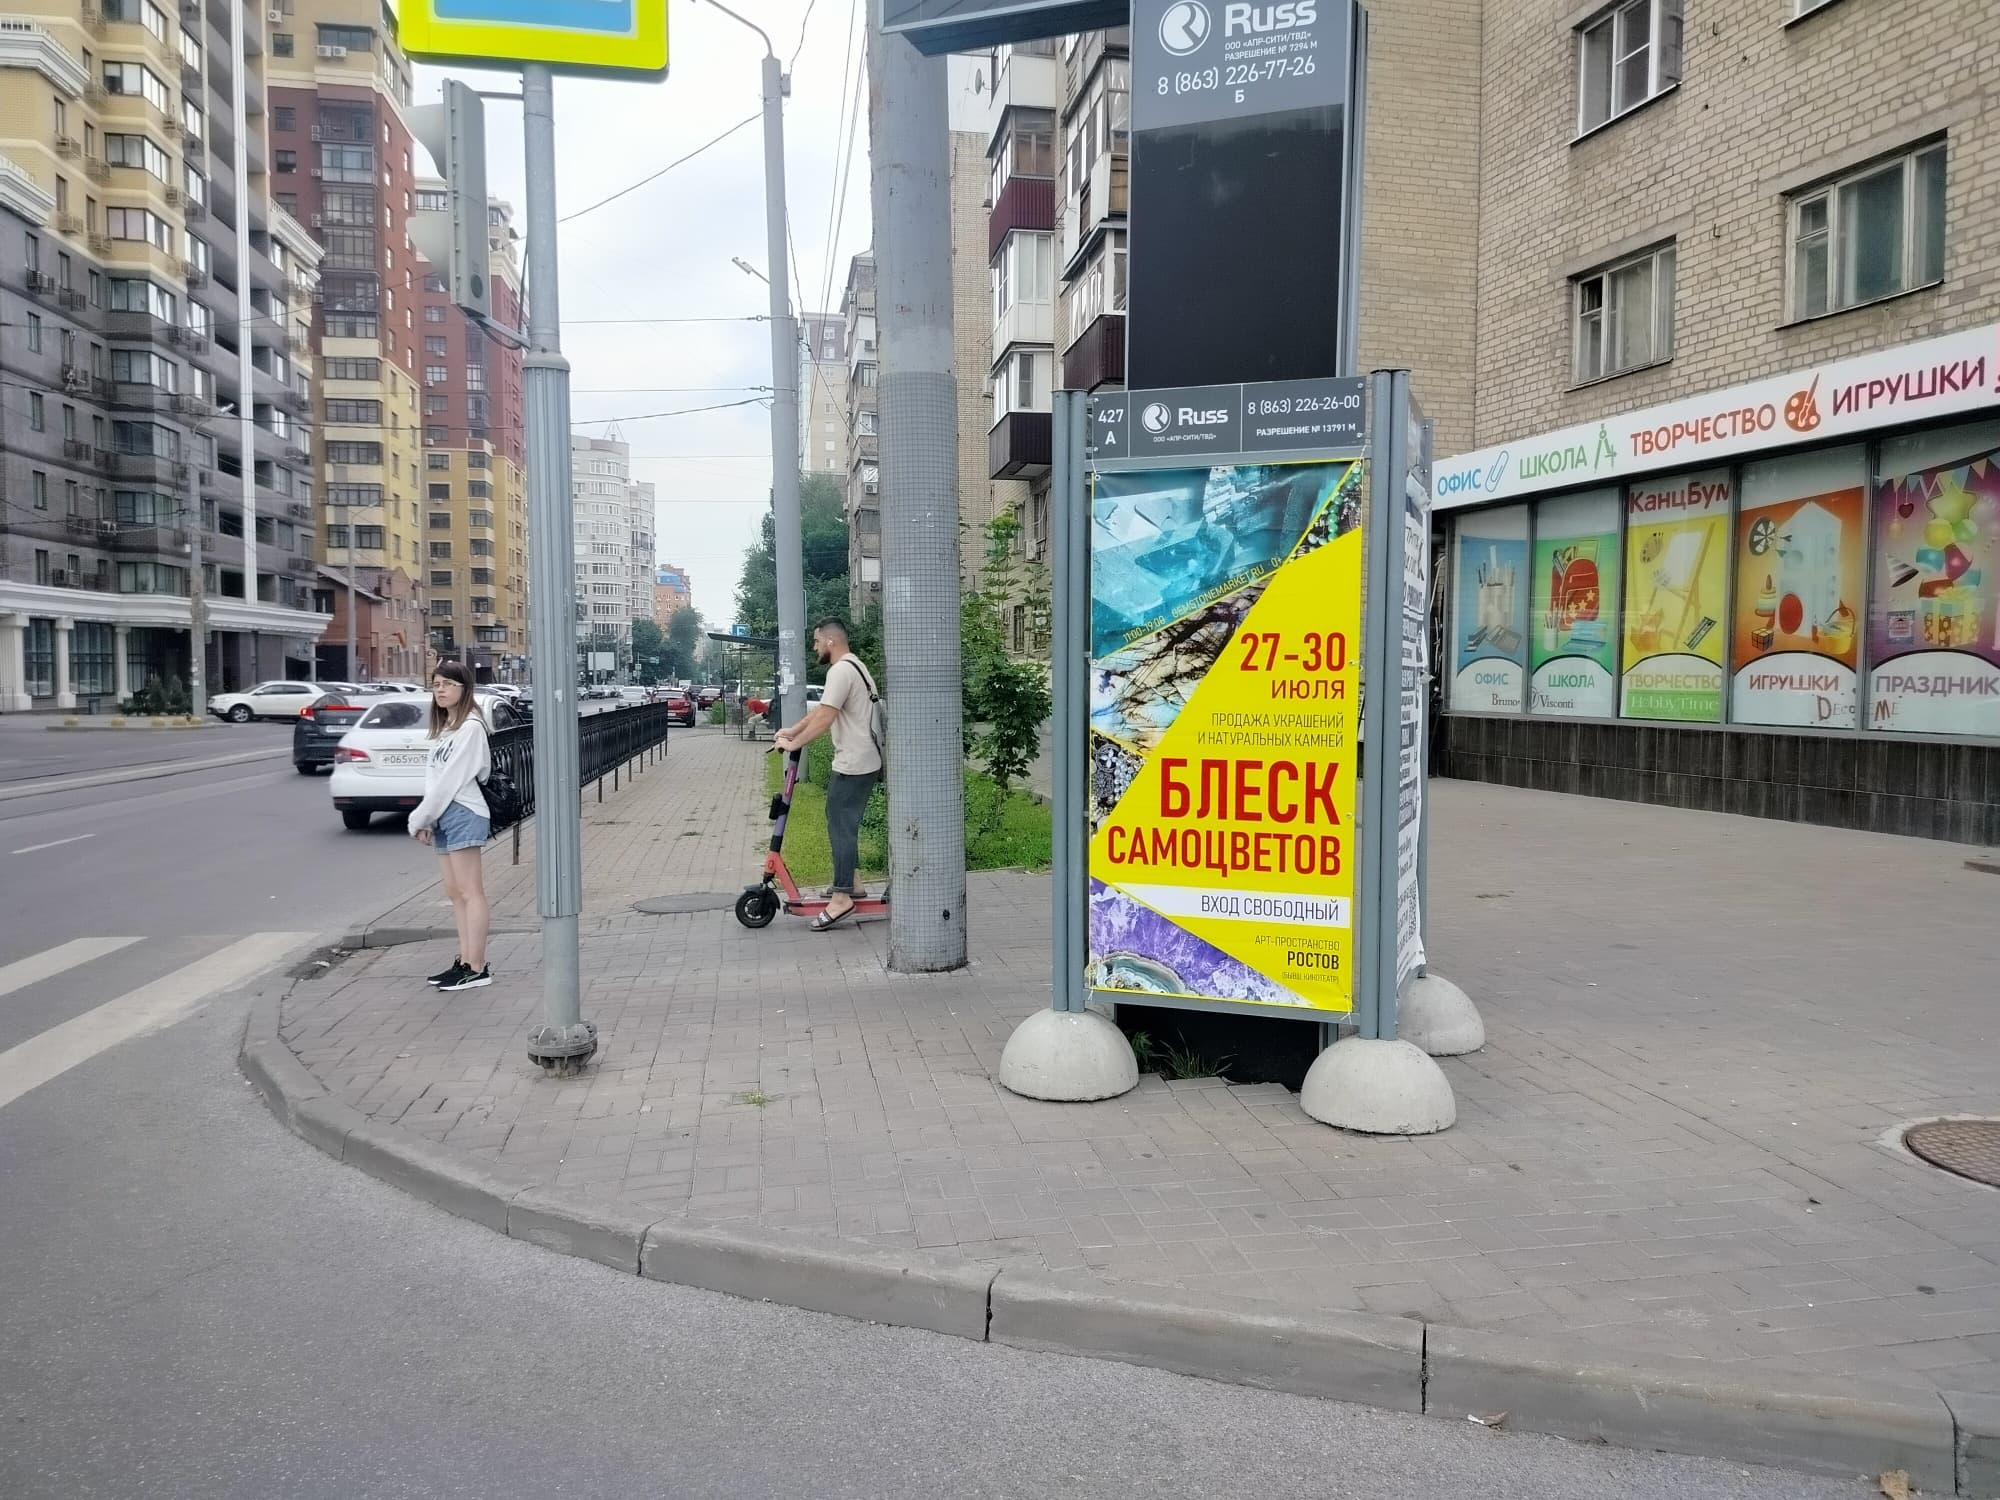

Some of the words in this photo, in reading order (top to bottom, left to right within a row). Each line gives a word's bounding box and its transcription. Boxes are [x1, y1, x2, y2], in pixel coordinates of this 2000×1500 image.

[1225, 0, 1317, 37] Russ
[1224, 48, 1276, 62] РАЗРЕШЕНИЕ
[1289, 42, 1308, 52] 7294
[1225, 42, 1241, 51] ООО
[1157, 76, 1169, 95] 8
[1175, 66, 1219, 95] (863)
[1225, 55, 1316, 86] 226-77-26
[1235, 89, 1245, 103] Б
[1247, 402, 1256, 415] 8
[1260, 398, 1291, 416] (863)
[1295, 395, 1360, 412] 226-26-00
[1098, 408, 1124, 423] 427
[1178, 407, 1229, 426] Russ
[1256, 425, 1310, 437] РАЗРЕШЕНИЕ
[1322, 423, 1346, 433] 13791
[1437, 468, 1482, 496] ОФИС
[1519, 445, 1588, 480] ШКОЛА
[1630, 403, 1776, 457] ТВОРЧЕСТВО
[1833, 356, 1985, 416] ИГРУШКИ
[1240, 632, 1346, 672] 27-30
[1475, 672, 1509, 686] ОФИС
[1548, 674, 1595, 689] ШКОЛА
[1750, 674, 1839, 692] ИГРУШКИ
[1876, 675, 2000, 696] ПРАЗДНИК
[1271, 679, 1345, 700] ИЮЛЯ
[1540, 694, 1574, 709] Visconti
[1212, 713, 1270, 728] ПРОДАЖА
[1273, 712, 1344, 728] УКРАШЕНИЙ
[1198, 732, 1205, 744] И
[1208, 732, 1291, 746] НАТУРАЛЬНЫХ
[1294, 731, 1344, 748] КАМНЕЙ
[1160, 758, 1341, 825] БЛЕСК
[1107, 825, 1341, 878] САМОЦВЕТОВ
[1201, 895, 1239, 918] ВХОД
[1243, 898, 1339, 922] СВОБОДНЫЙ
[1255, 935, 1340, 951] АРТ-ПРОСТРАНСТВО
[1287, 951, 1339, 970] РОСТОВ
